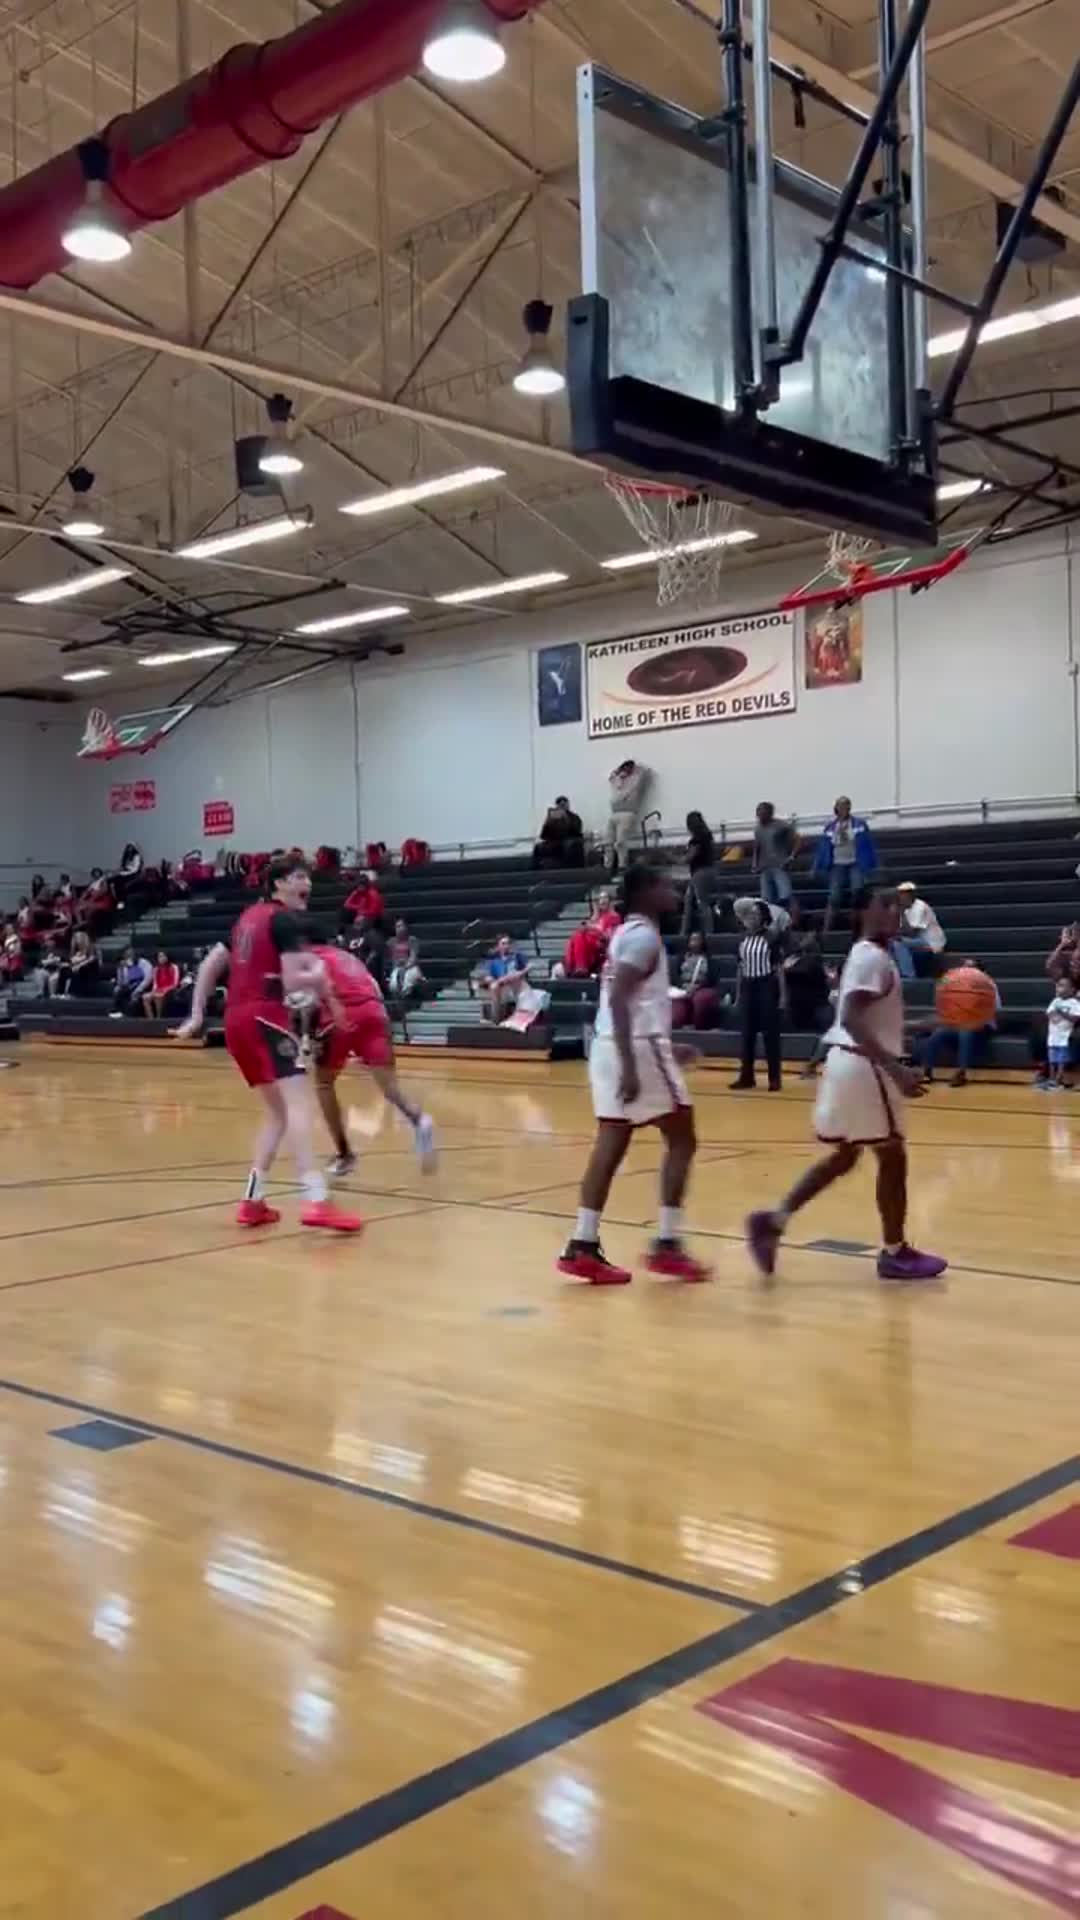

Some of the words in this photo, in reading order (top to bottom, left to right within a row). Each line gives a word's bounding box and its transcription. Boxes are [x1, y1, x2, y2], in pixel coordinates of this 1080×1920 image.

[589, 636, 669, 658] KATHLEEN
[674, 628, 716, 644] HIGH
[720, 614, 791, 636] SCHOOL
[592, 713, 633, 732] HOME
[637, 709, 657, 726] OF
[661, 705, 692, 723] THE
[695, 700, 727, 718] RED
[732, 690, 791, 713] DEVILS
